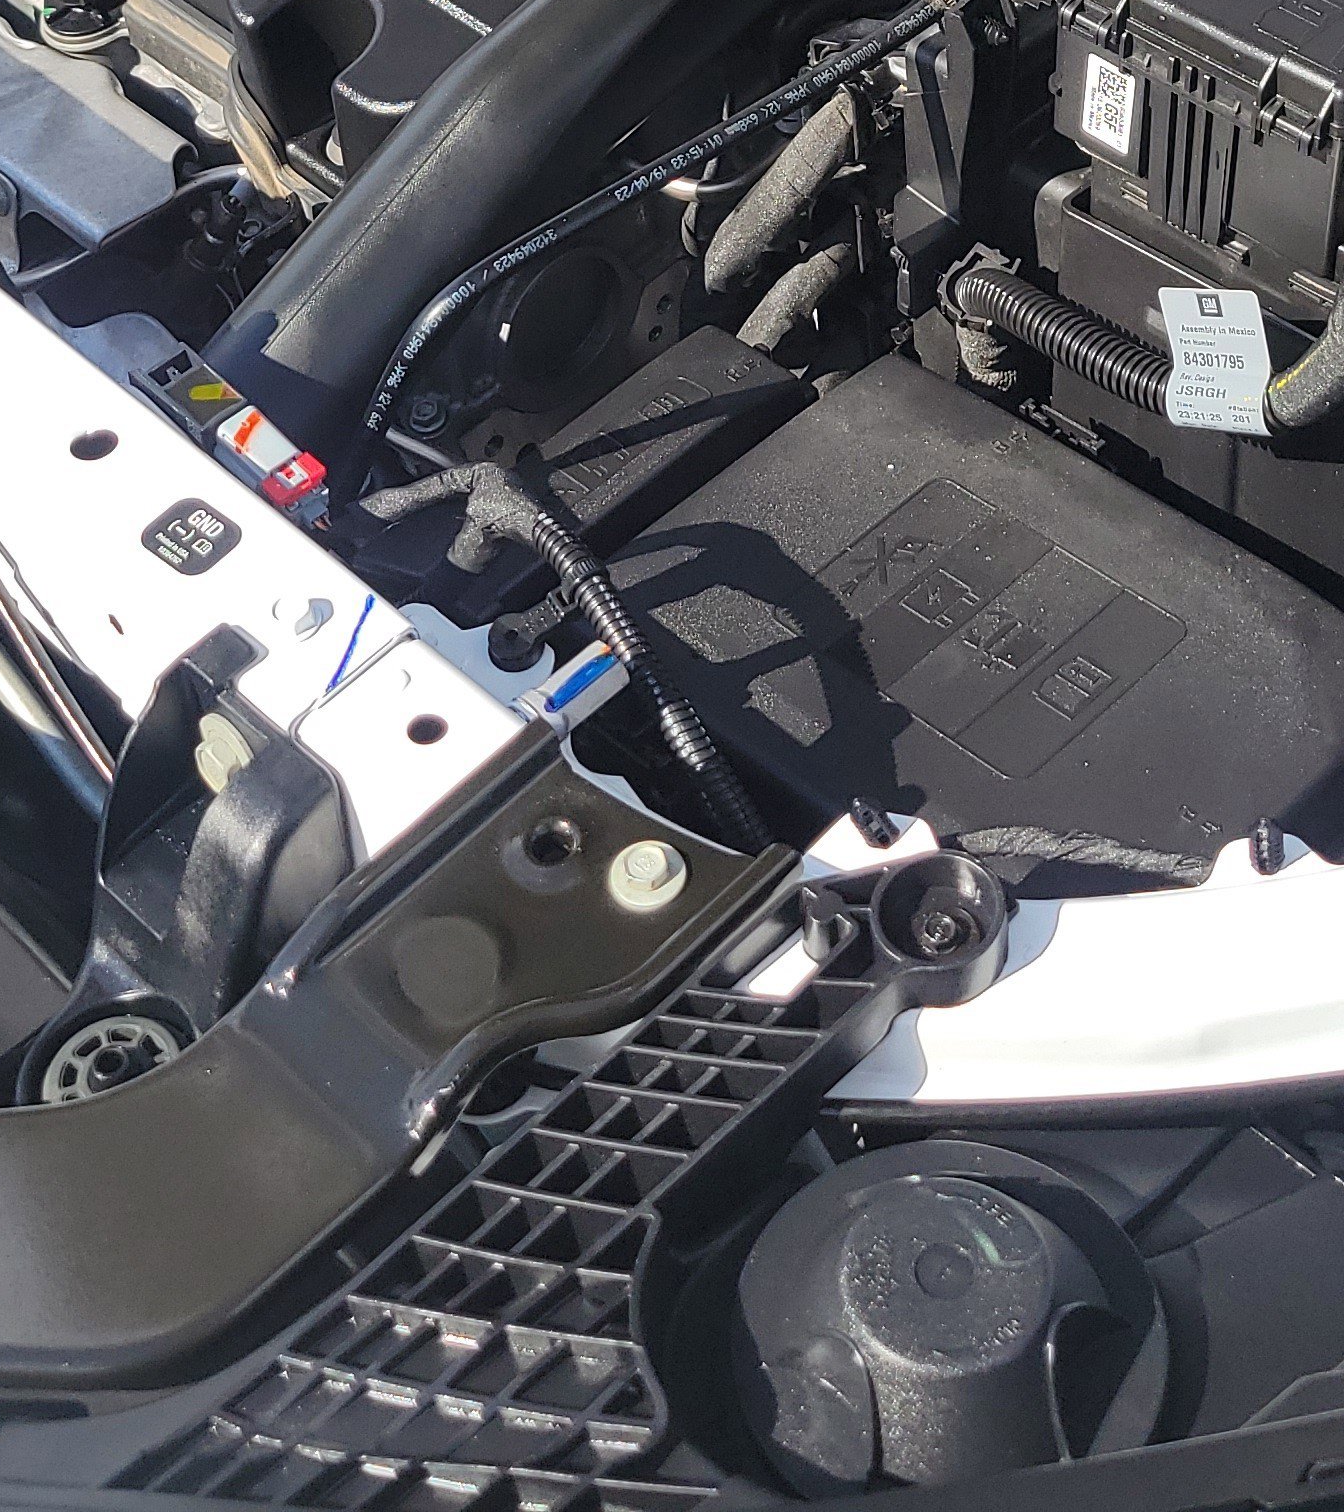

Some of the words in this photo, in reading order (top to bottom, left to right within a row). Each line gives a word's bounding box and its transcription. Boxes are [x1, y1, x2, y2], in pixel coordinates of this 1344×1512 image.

[1103, 102, 1119, 134] G5F
[1181, 324, 1216, 336] Assembly
[1228, 326, 1256, 336] Mexico
[1183, 351, 1245, 370] 84301795
[1175, 385, 1227, 399] JSRGH
[1177, 410, 1223, 422] 23:21:25
[1232, 414, 1252, 424] 201
[187, 509, 227, 537] GND
